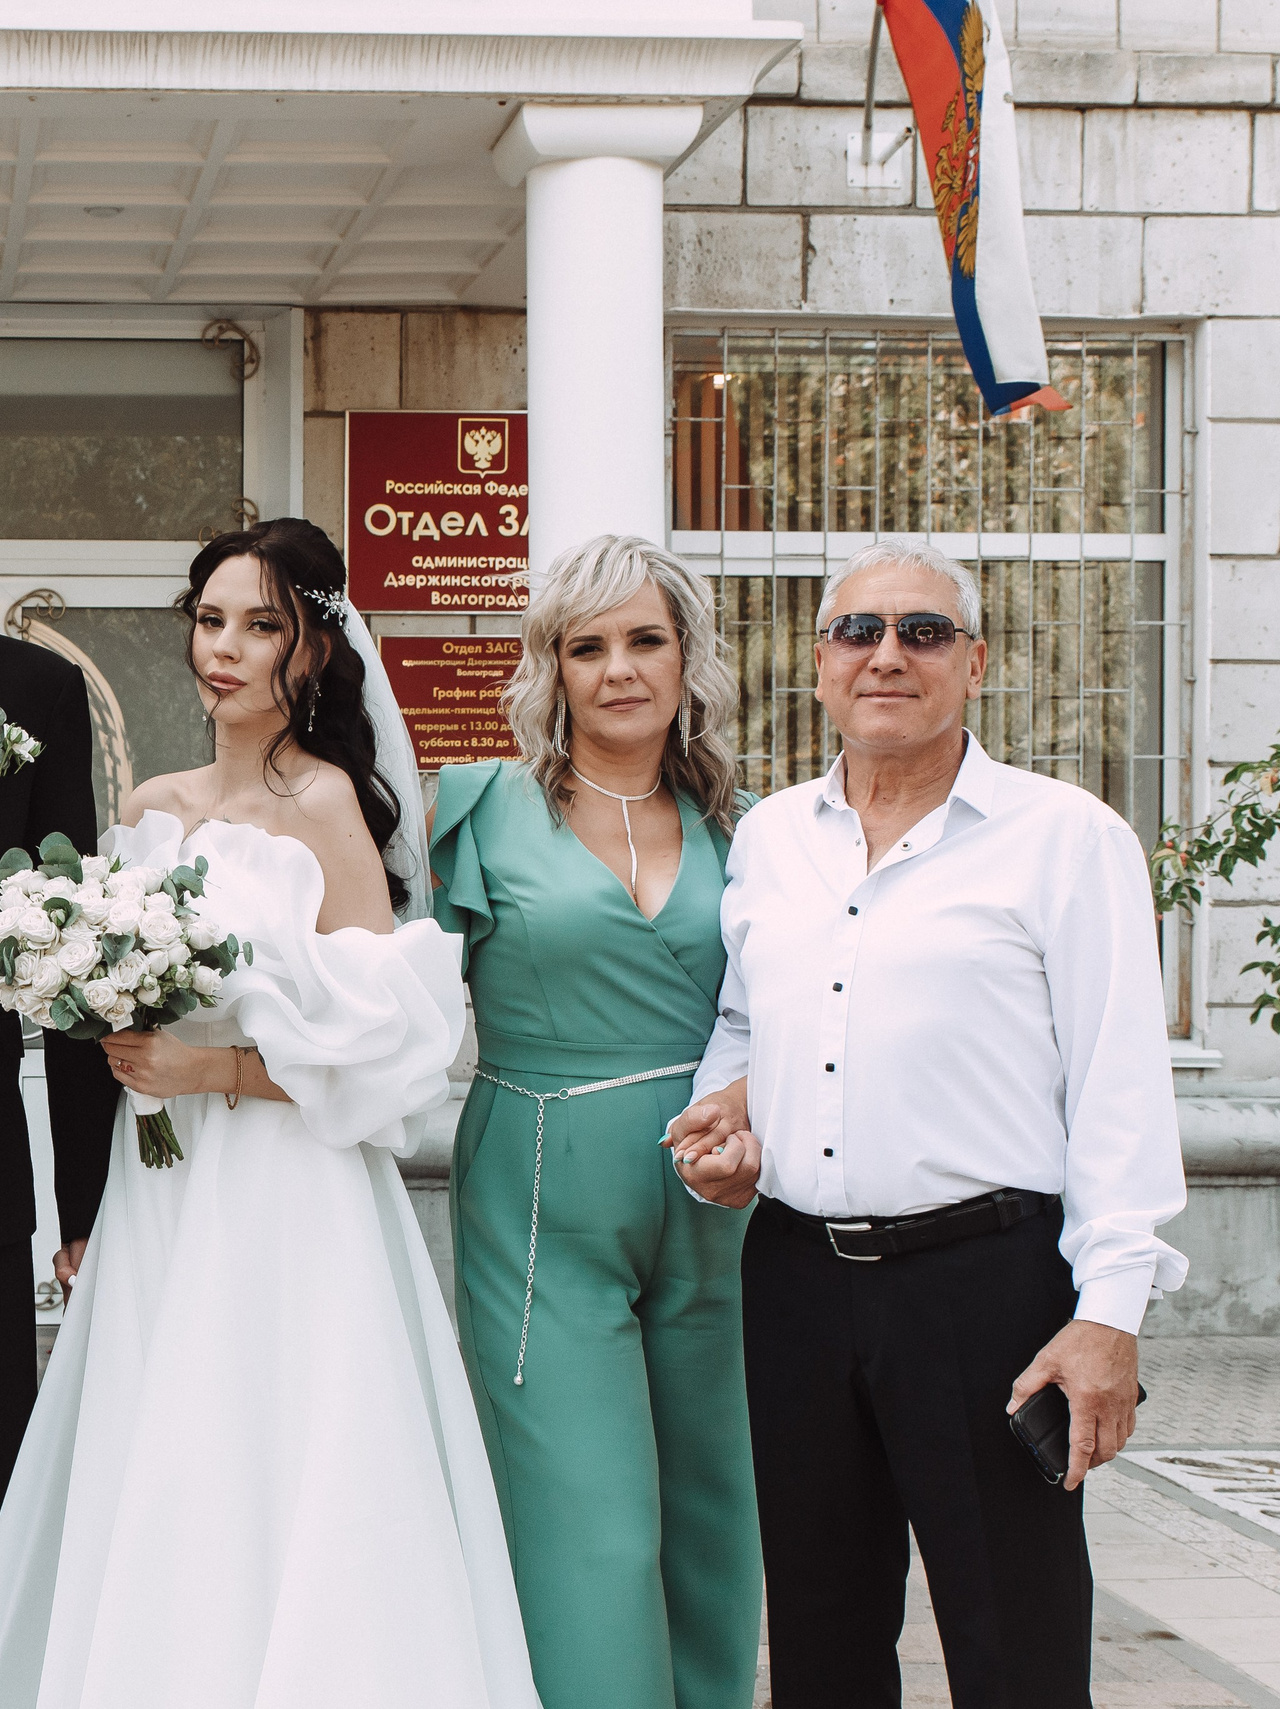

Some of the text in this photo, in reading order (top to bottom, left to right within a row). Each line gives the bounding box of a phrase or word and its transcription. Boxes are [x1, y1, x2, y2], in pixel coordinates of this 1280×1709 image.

[385, 479, 529, 498] Российская Феде
[364, 503, 489, 541] Отдел
[411, 555, 530, 571] администрац
[383, 571, 509, 589] Дзержинского
[431, 591, 529, 608] Волгограда
[442, 642, 519, 655] Отдел ЗАГС
[433, 687, 477, 700] График
[414, 723, 459, 733] перерыв
[469, 721, 499, 731] 13.00
[418, 737, 461, 749] суббота
[471, 737, 494, 747] 8.30
[495, 740, 510, 748] до
